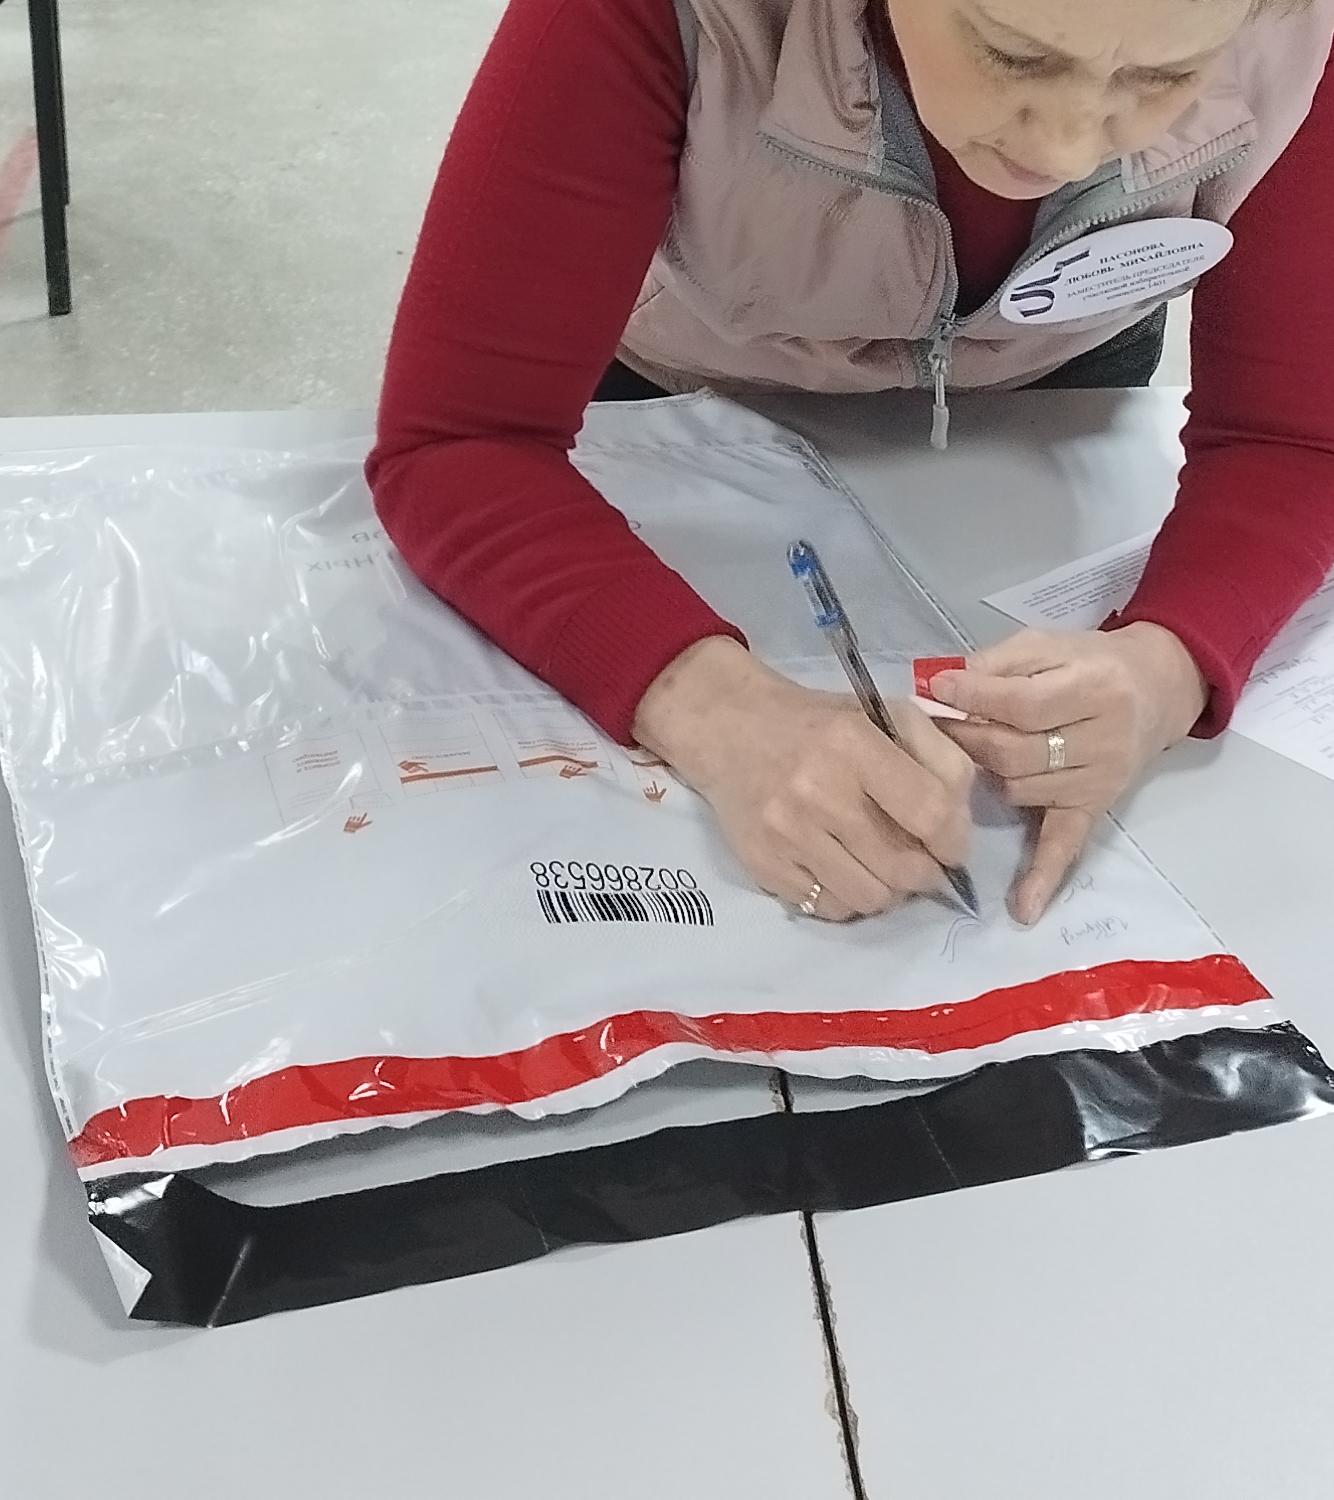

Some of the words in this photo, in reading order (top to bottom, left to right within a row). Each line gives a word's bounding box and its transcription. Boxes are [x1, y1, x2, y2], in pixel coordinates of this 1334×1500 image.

[1064, 266, 1115, 286] ЛЮБОВЬ
[1119, 242, 1204, 268] МИХАЙЛОВНА
[1067, 274, 1132, 298] ЗАМЕСТИТЕЛЬ
[1132, 255, 1205, 278] ПРЕДСЕДАТЕЛЯ
[530, 861, 698, 891] 002866538
